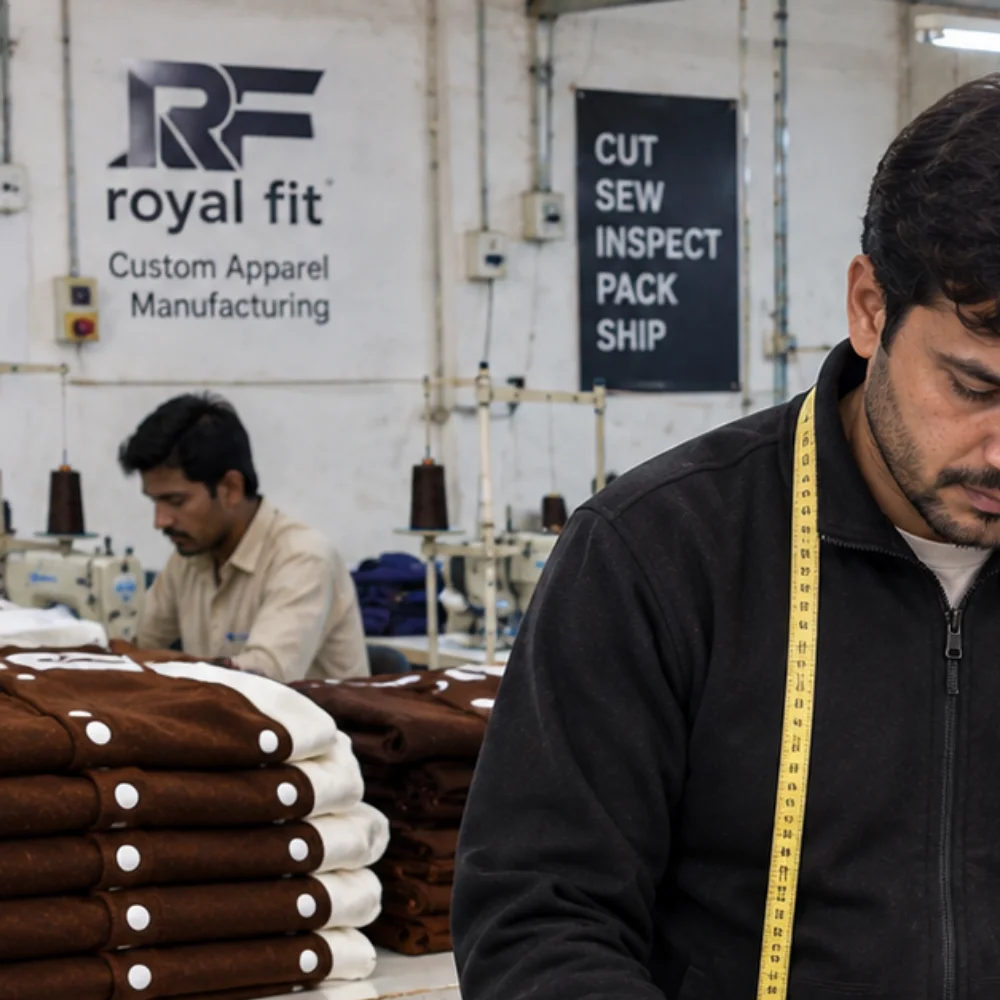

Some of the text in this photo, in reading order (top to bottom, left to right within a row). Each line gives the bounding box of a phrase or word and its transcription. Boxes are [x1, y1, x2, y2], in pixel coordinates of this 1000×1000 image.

[109, 62, 324, 171] RF
[595, 133, 658, 166] CUT
[107, 179, 322, 235] royal fit
[596, 179, 664, 212] SEW
[597, 226, 722, 259] INSPECT
[109, 251, 328, 286] Custom Apparel
[597, 272, 677, 305] PACK
[131, 291, 330, 326] Manufacturing
[597, 319, 666, 351] SHIP
